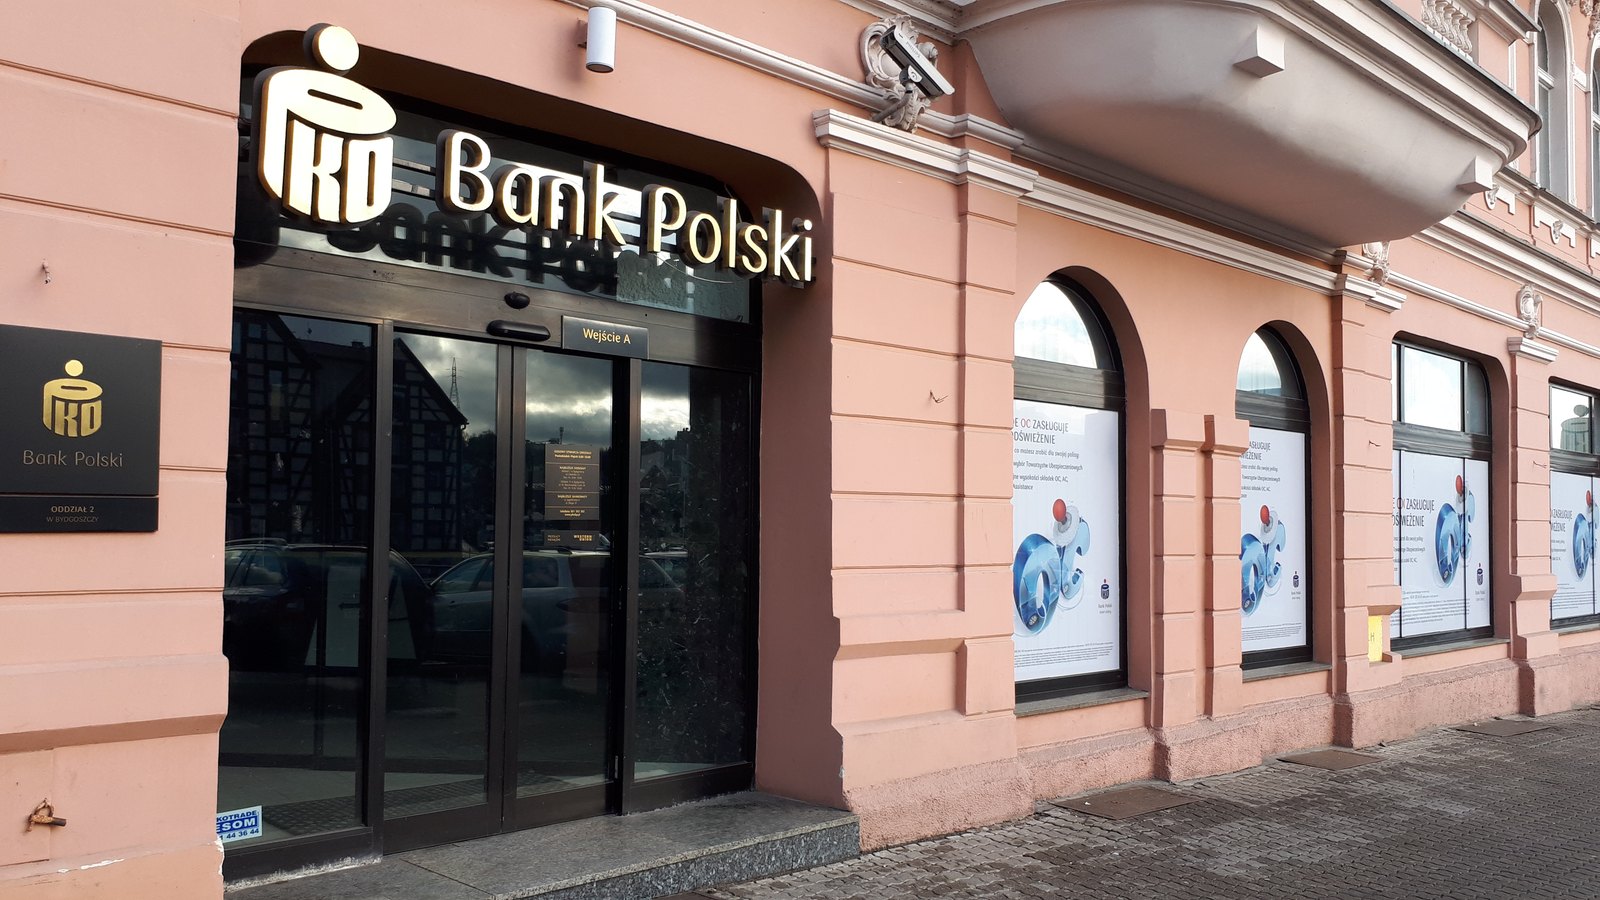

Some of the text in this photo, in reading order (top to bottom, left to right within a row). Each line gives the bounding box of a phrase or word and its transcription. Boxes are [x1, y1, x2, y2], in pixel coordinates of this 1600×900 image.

[444, 131, 627, 246] Bank
[645, 185, 813, 283] Polski
[582, 327, 631, 345] Wejście A
[1032, 419, 1069, 434] ZASŁUGUJE
[23, 449, 123, 468] Bank Polski
[50, 505, 88, 514] ODDZIAŁ
